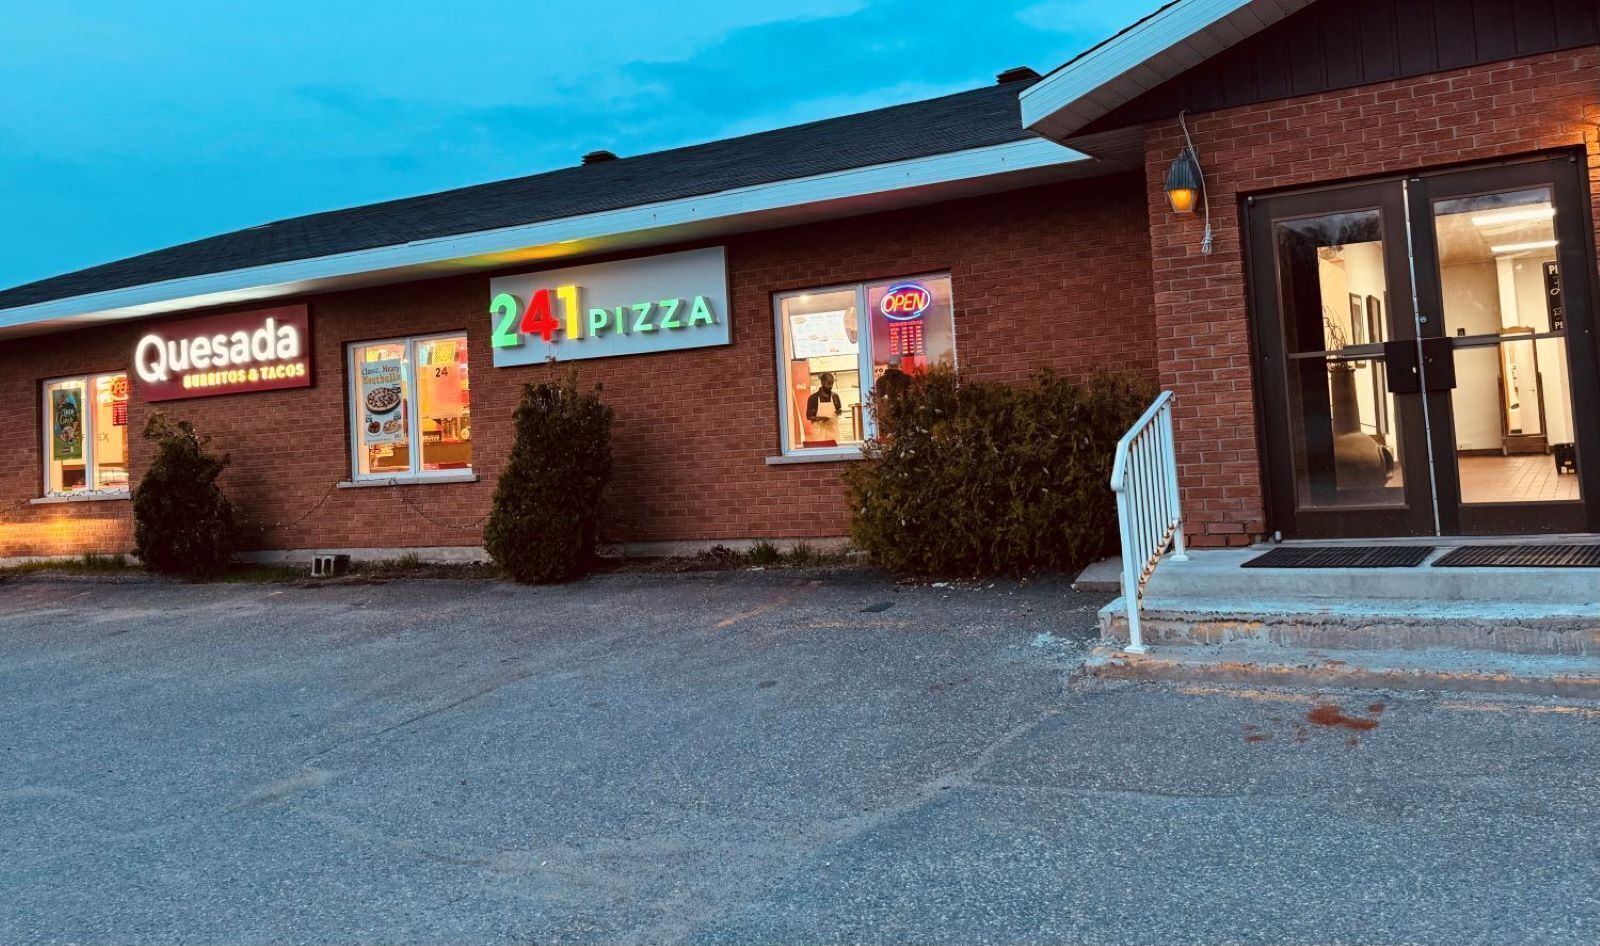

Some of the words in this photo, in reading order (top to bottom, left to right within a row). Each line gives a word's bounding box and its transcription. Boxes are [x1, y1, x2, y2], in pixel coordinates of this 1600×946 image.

[489, 284, 583, 348] 241
[589, 295, 718, 337] PIZZA
[884, 292, 925, 312] OPEN
[135, 317, 299, 382] Quesada
[183, 369, 246, 388] BURRITOS
[248, 368, 259, 382] &
[260, 363, 305, 380] TACOS
